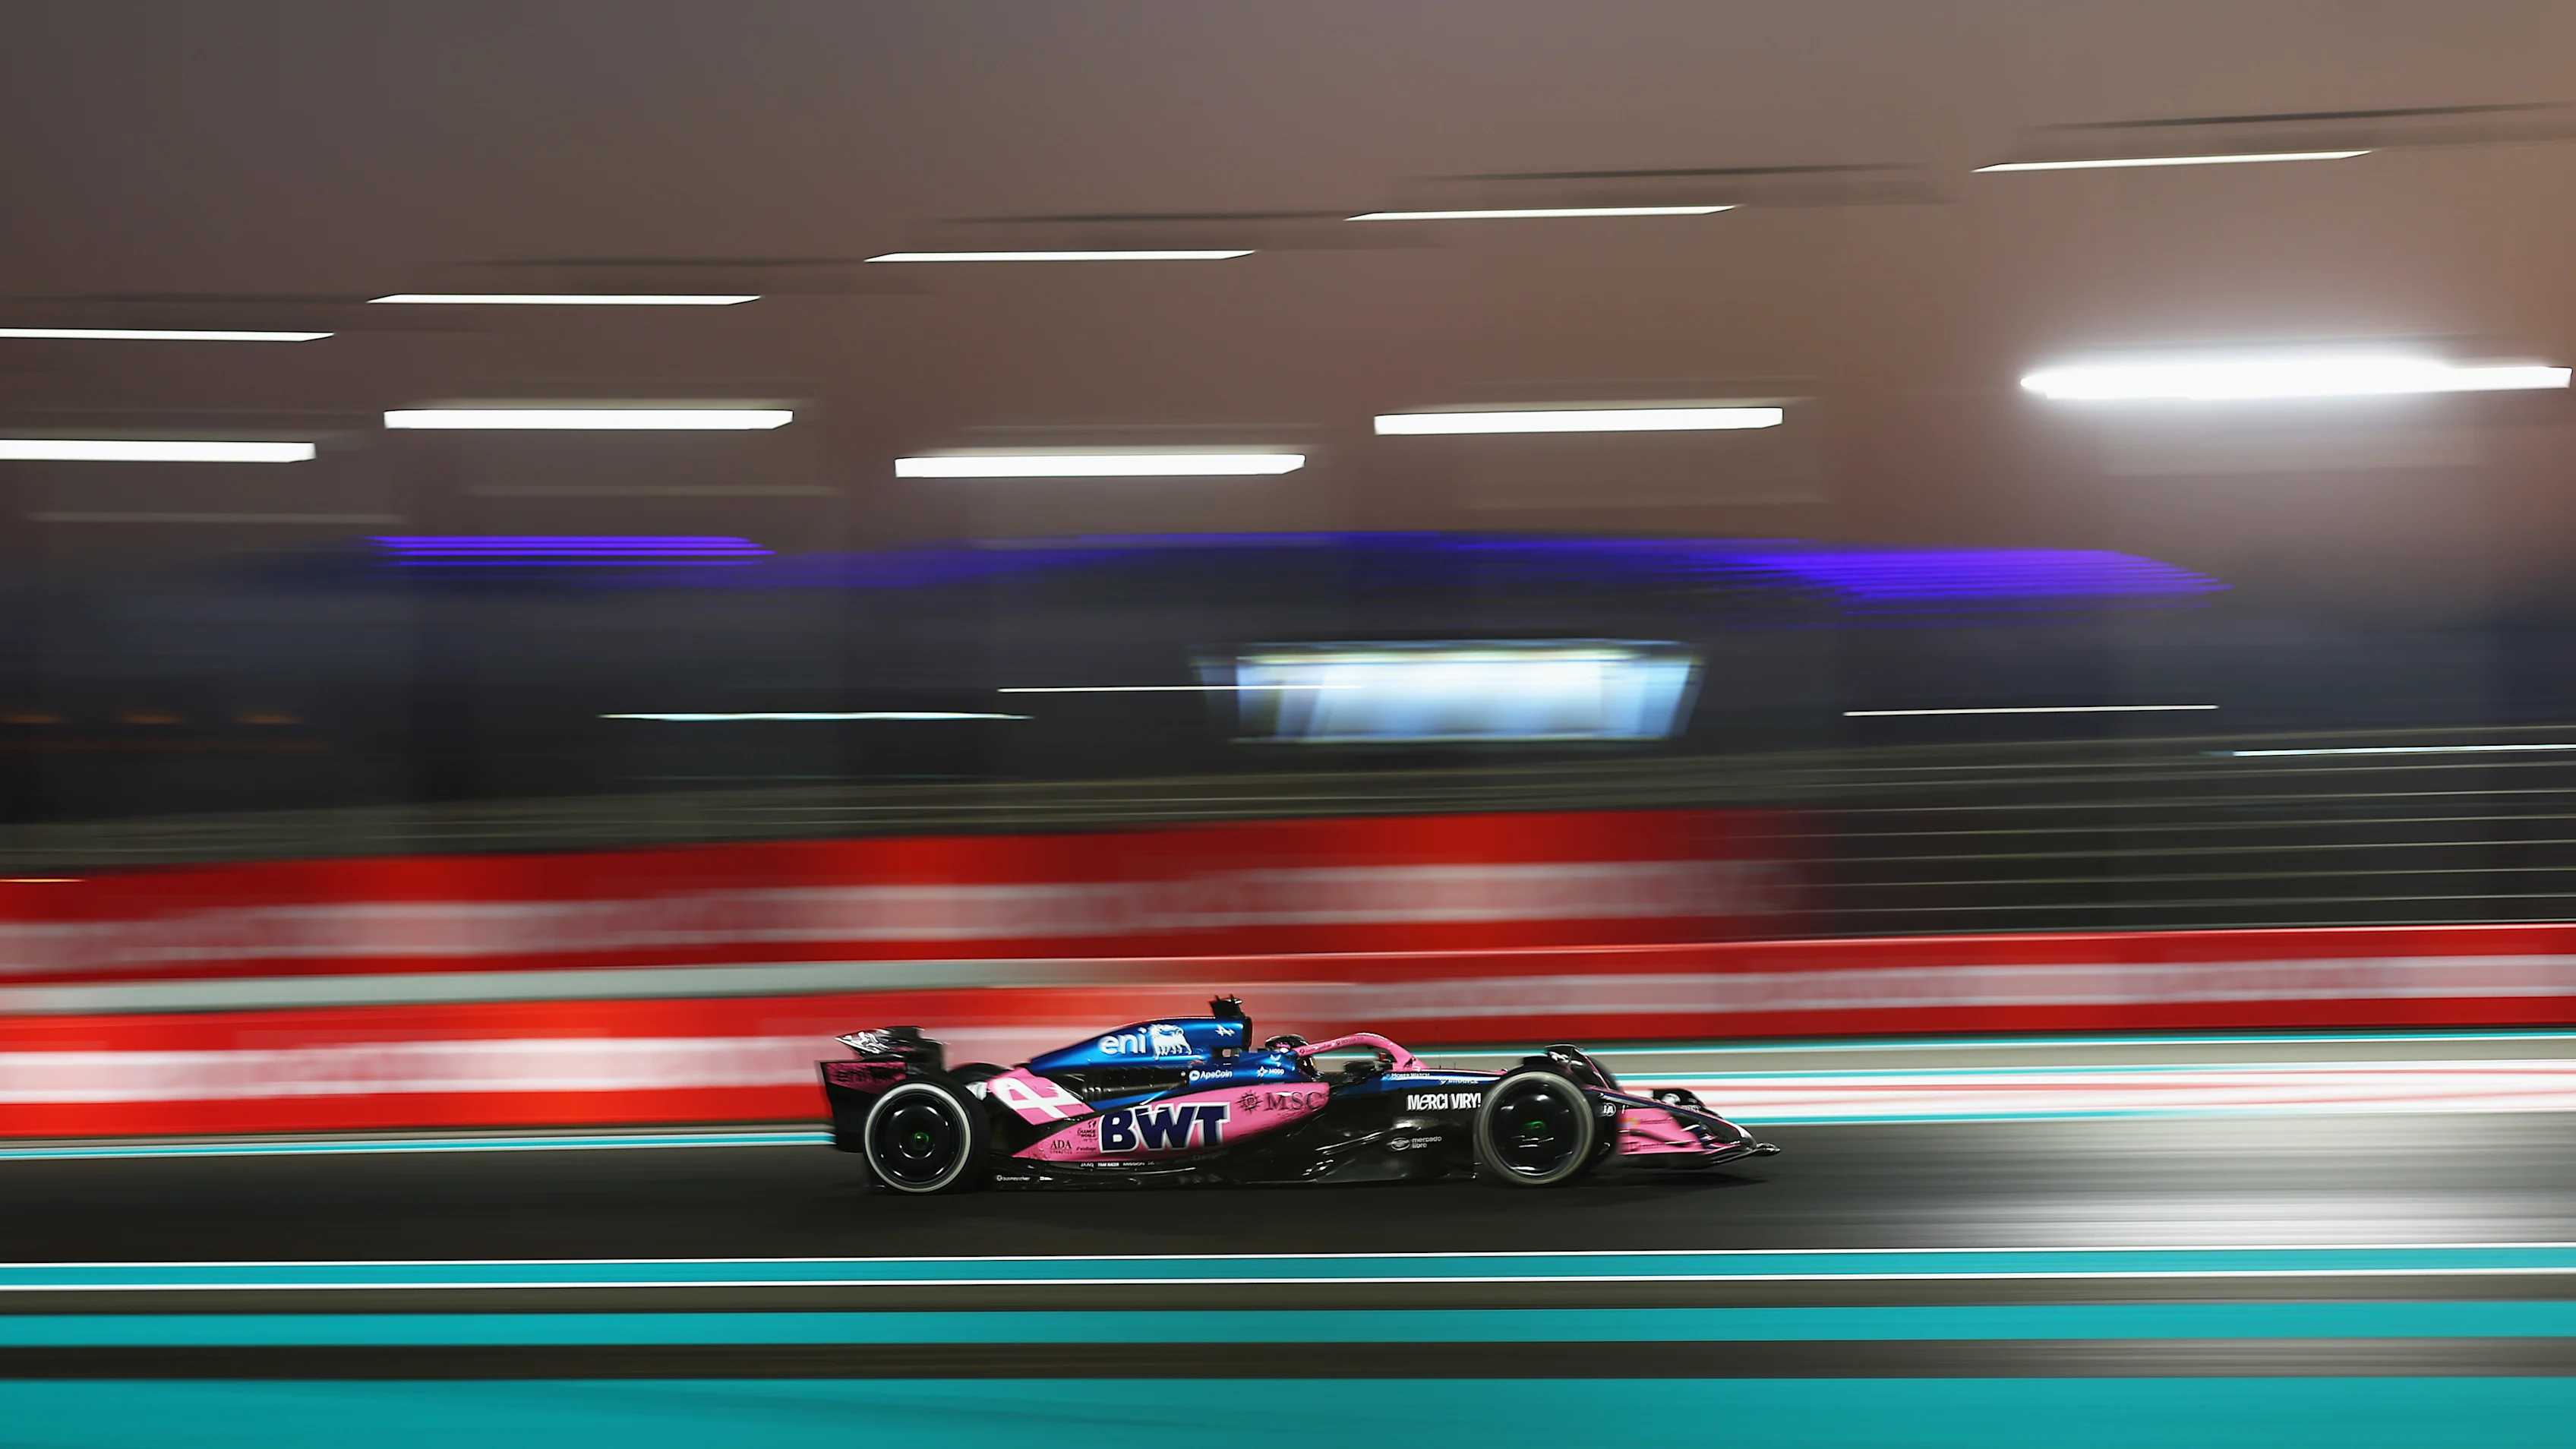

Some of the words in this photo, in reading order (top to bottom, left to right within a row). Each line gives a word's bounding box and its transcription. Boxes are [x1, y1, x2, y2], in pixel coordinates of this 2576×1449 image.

[1097, 1027, 1147, 1055] eni
[1200, 1069, 1233, 1080] ApeCoin
[1263, 1091, 1323, 1111] MSC
[1450, 1092, 1482, 1110] VIRY!
[1098, 1101, 1230, 1153] BWT
[1050, 1139, 1072, 1150] ADA
